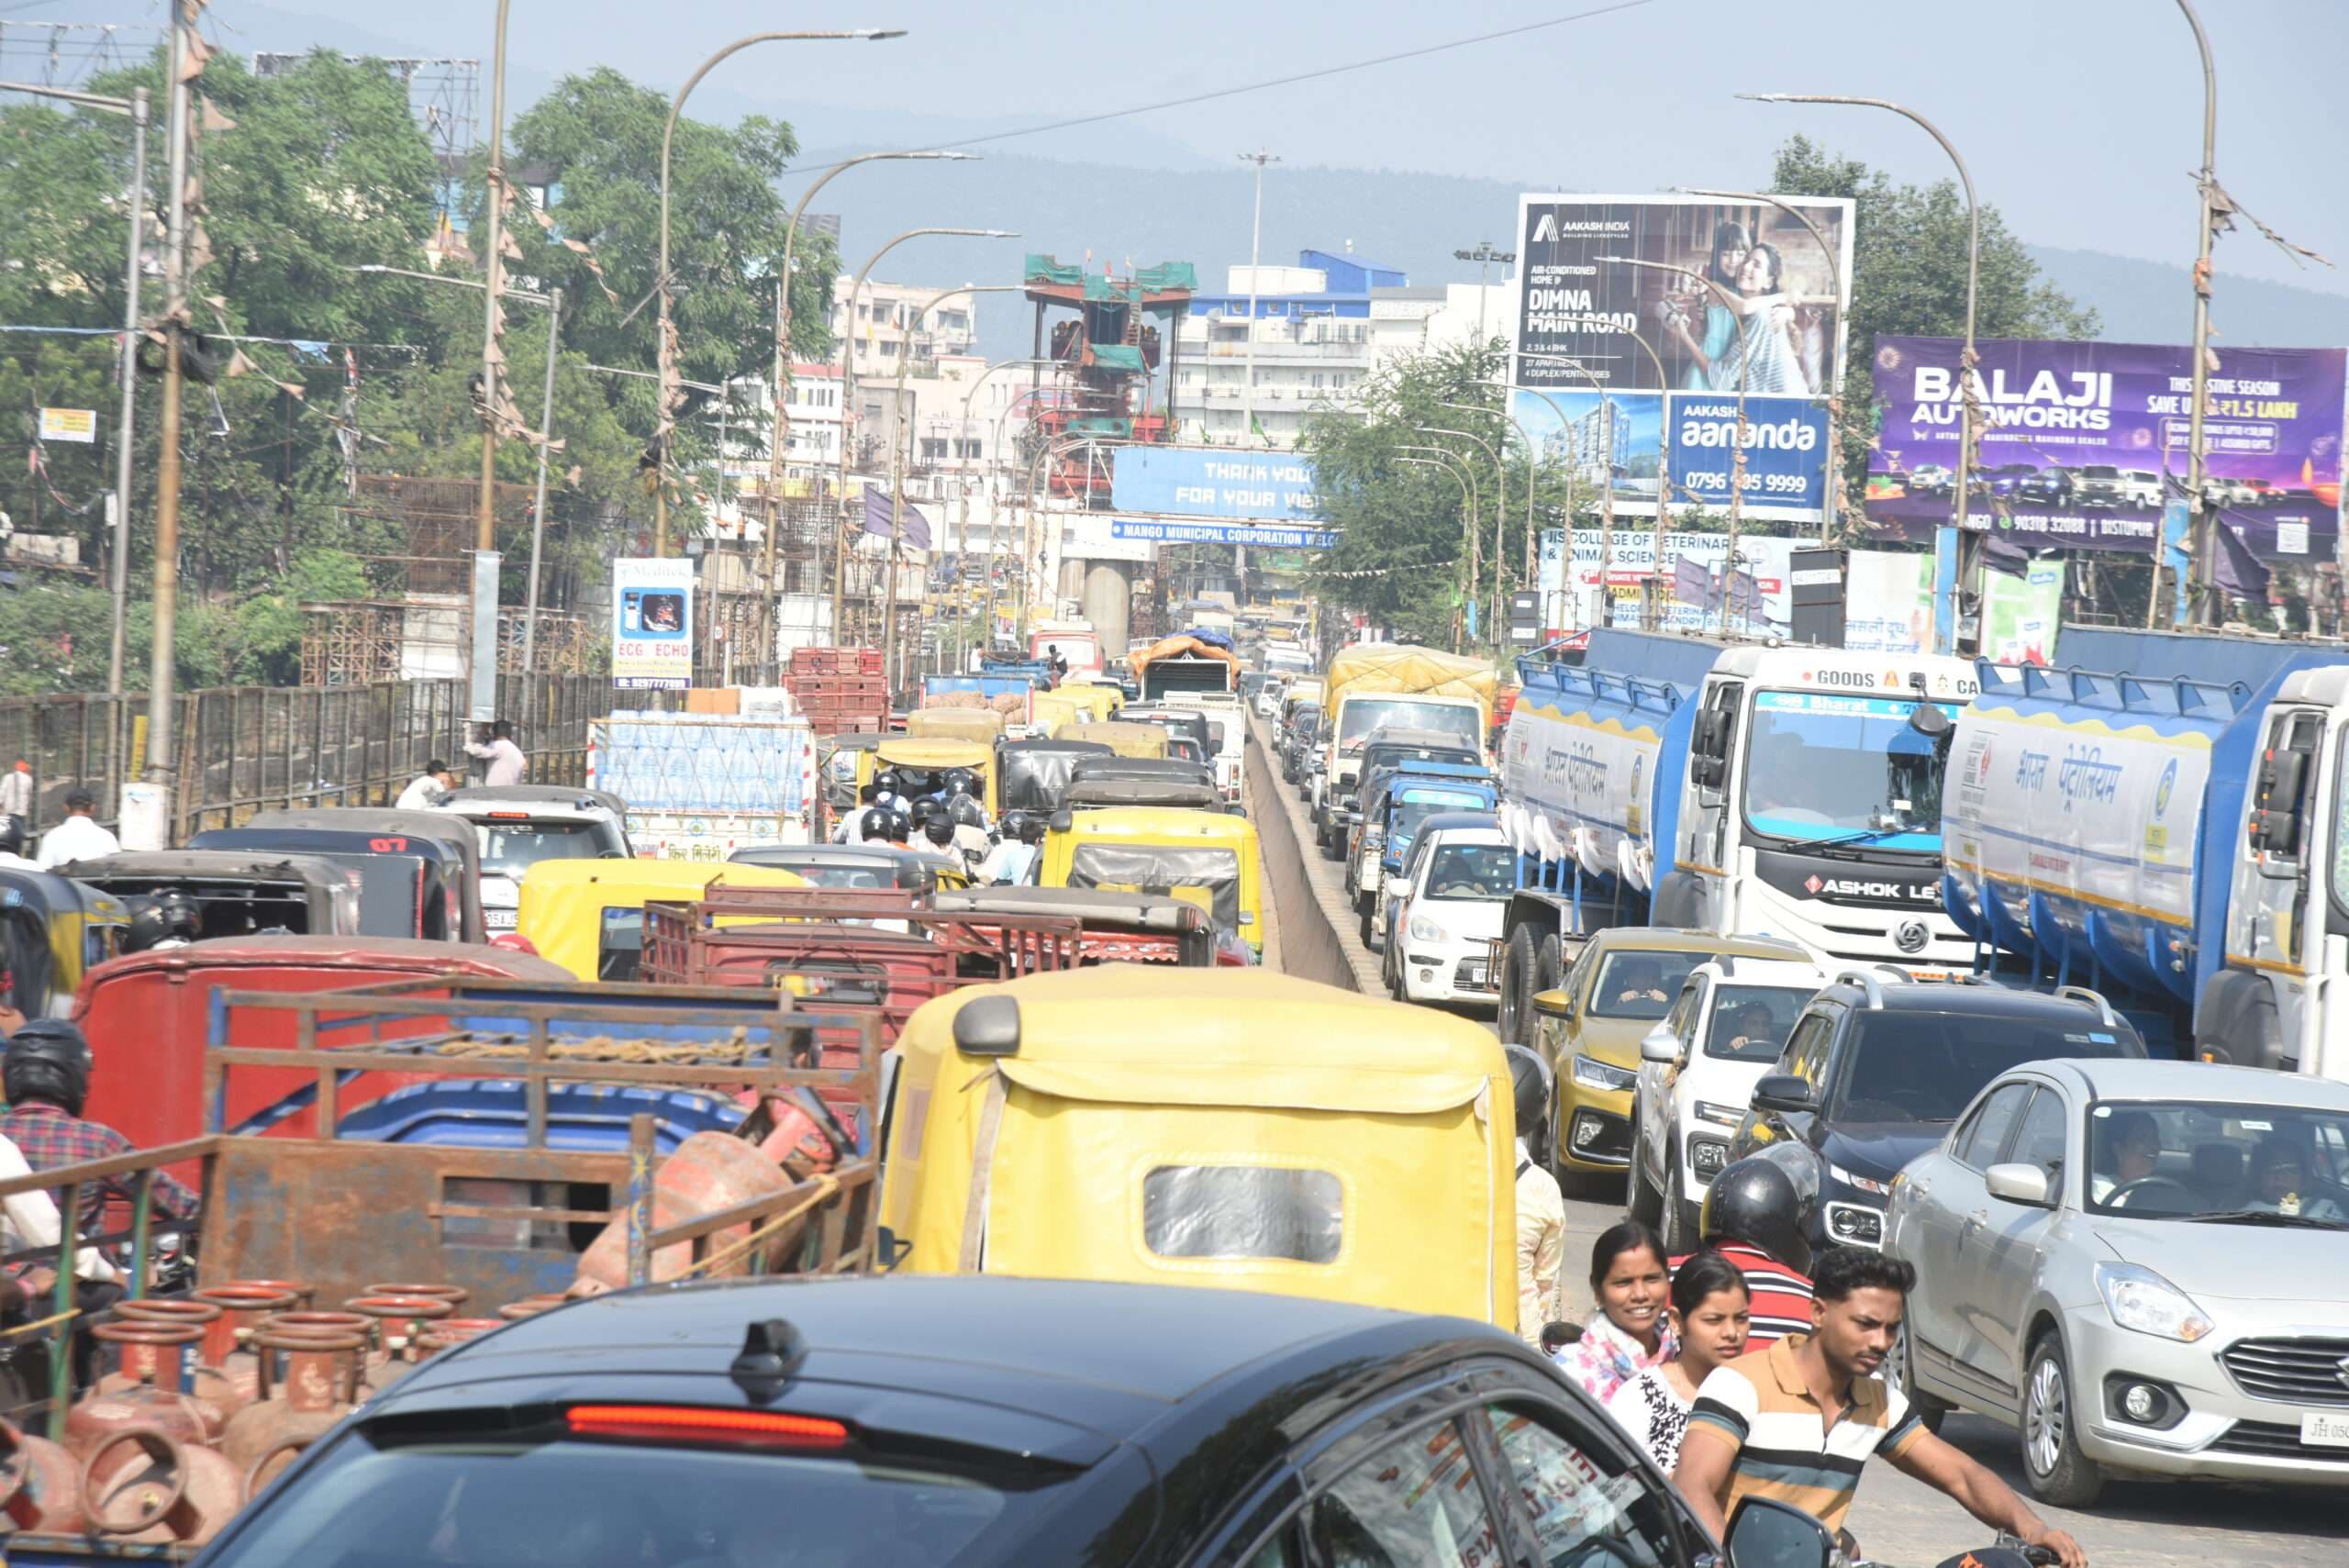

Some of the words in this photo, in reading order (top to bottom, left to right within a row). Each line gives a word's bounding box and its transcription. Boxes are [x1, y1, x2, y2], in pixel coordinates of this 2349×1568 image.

[1563, 221, 1602, 231] AAKASH
[1604, 221, 1630, 231] INDIA
[1531, 265, 1597, 275] AIR-CONDITIONED
[1531, 275, 1553, 284] HOME
[1529, 289, 1592, 311] DIMNA
[1528, 311, 1577, 332] MAIN
[1582, 312, 1637, 334] ROAD
[1914, 366, 2113, 407] BALAJI
[1683, 406, 1738, 417] AAKASH
[2146, 395, 2180, 414] SAVE
[2256, 401, 2299, 418] LAKH
[1681, 418, 1817, 450] aananda
[1205, 462, 1267, 481] THANK
[1274, 466, 1311, 484] YOU
[1686, 472, 1727, 489] 0796
[1765, 474, 1807, 493] 9999
[1174, 487, 1215, 504] FOR
[1222, 490, 1276, 506] YOUR
[1123, 524, 1163, 539] MANGO
[1166, 526, 1225, 540] MUNICIPAL
[1227, 528, 1301, 545] CORPORATION
[1572, 533, 1630, 546] COLLGE
[1633, 535, 1650, 546] OF
[1655, 536, 1733, 550] ETERINAR
[1619, 551, 1683, 565] SCIENCE
[618, 642, 643, 657] ECG
[655, 643, 689, 657] ECHO
[1818, 670, 1875, 687] GOODS
[1956, 679, 1978, 695] CA
[370, 837, 407, 852] 07
[1822, 879, 1901, 897] ASHOK
[1909, 884, 1935, 899] LE
